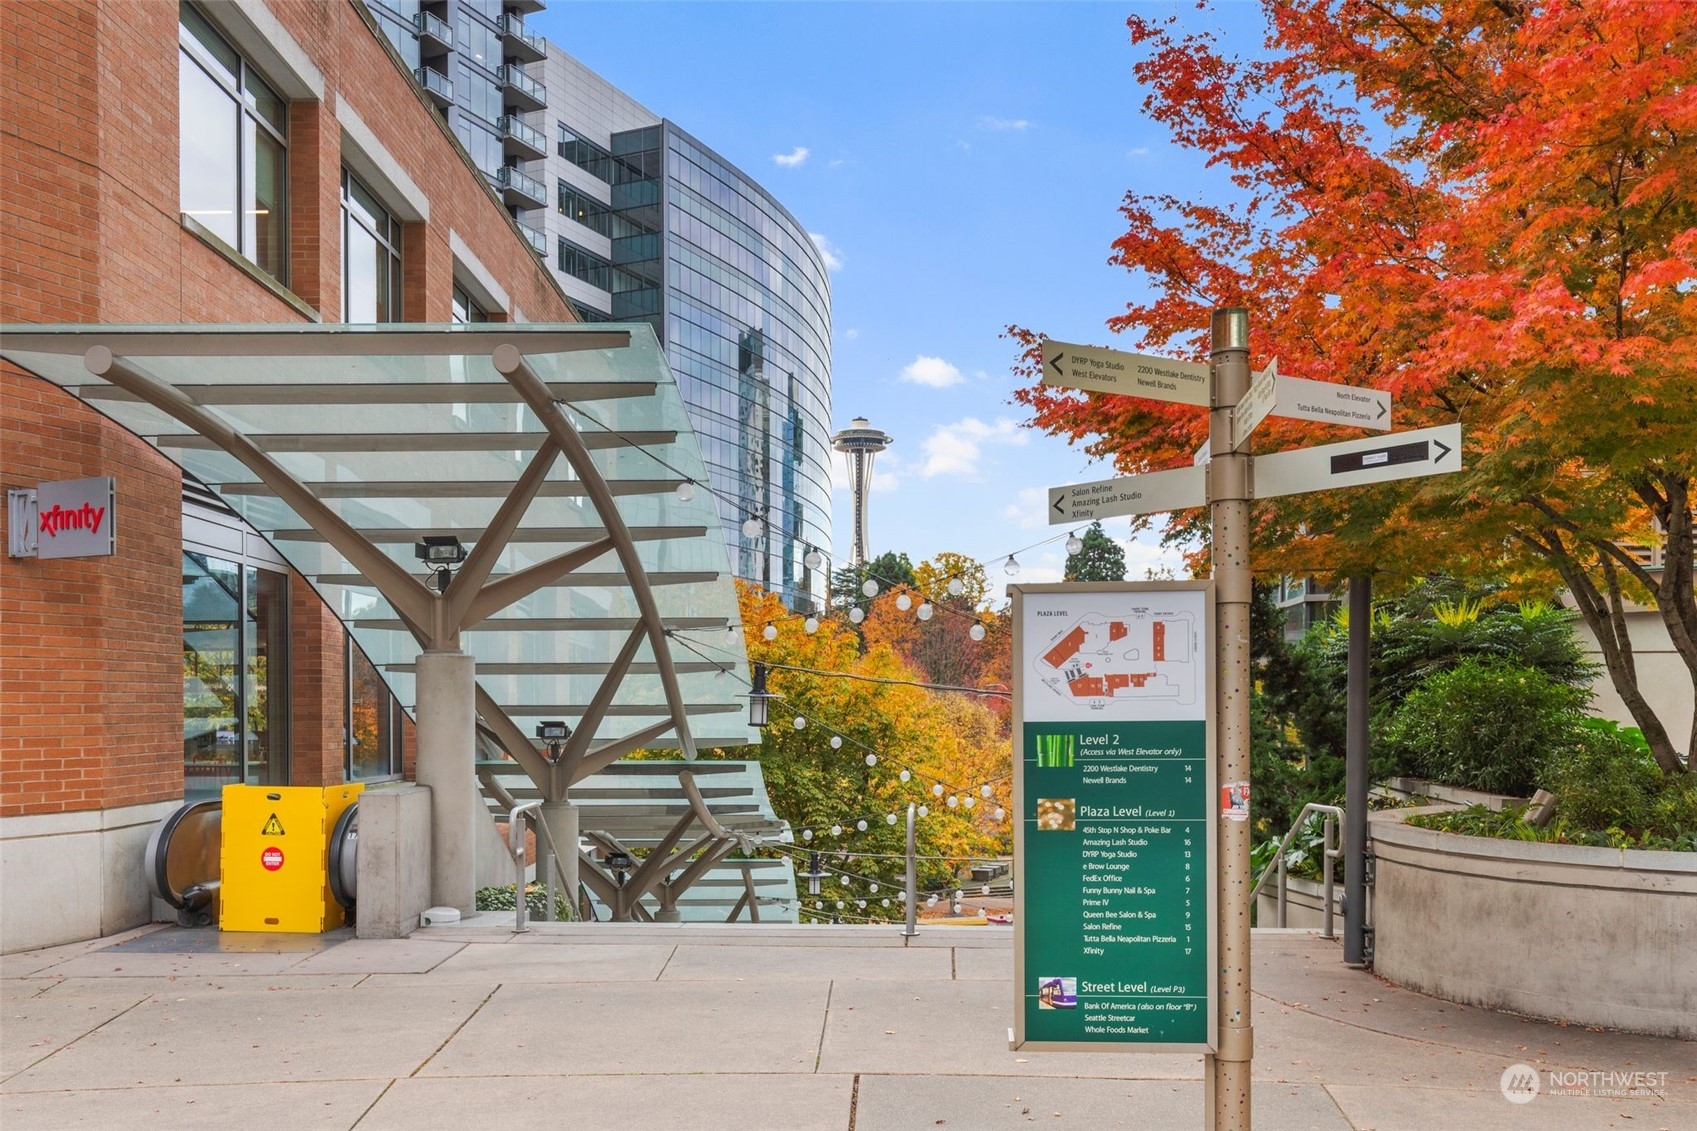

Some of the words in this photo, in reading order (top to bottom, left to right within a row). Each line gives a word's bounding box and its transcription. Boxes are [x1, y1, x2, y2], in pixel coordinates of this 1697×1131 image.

[1071, 355, 1089, 365] DYRP
[1089, 358, 1105, 369] Yoga
[1105, 360, 1125, 371] Studio
[1071, 369, 1088, 378] West
[1089, 371, 1117, 383] Elevators
[1137, 365, 1153, 374] 2200
[1153, 367, 1179, 379] Westlake
[1180, 371, 1206, 384] Dentistry
[1137, 378, 1156, 388] Newell
[1157, 380, 1177, 390] Brands
[1336, 391, 1350, 400] North
[1351, 393, 1371, 403] Elevator
[1297, 403, 1310, 412] Tutta
[1311, 405, 1324, 414] Bella
[1324, 407, 1351, 418] Neapolitan
[1351, 411, 1371, 420] Pizzeria
[1072, 487, 1090, 497] Salon
[1091, 484, 1113, 494] Refine
[1072, 497, 1100, 508] Amazing
[1101, 494, 1118, 504] Lash
[1119, 491, 1142, 502] Studio
[1072, 508, 1094, 519] Xfinity
[39, 502, 105, 537] xfinity
[1080, 734, 1108, 745] Level
[1112, 734, 1120, 745] 2
[1080, 748, 1104, 756] (Access
[1105, 748, 1116, 756] via
[1118, 748, 1135, 756] West
[1135, 747, 1162, 756] Elevator
[1163, 748, 1182, 757] only)
[1083, 765, 1099, 774] 2200
[1100, 765, 1128, 774] Westlake
[1129, 765, 1159, 774] Dentistry
[1184, 765, 1192, 773] 14
[1083, 776, 1104, 785] Newell
[1105, 776, 1127, 785] Brands
[1184, 776, 1192, 784] 14
[1080, 805, 1110, 817] Plaza
[1113, 805, 1142, 817] Level
[1145, 809, 1167, 818] (Level
[1168, 809, 1176, 818] 1)
[1083, 827, 1096, 835] 45th
[1097, 827, 1112, 835] Stop
[1120, 827, 1136, 835] Shop
[1144, 827, 1159, 835] Poke
[1161, 827, 1172, 835] Bar
[1184, 827, 1190, 835] 4
[1083, 839, 1110, 847] Amazing
[1111, 839, 1127, 847] Lash
[1127, 839, 1148, 847] Studio
[1184, 839, 1192, 847] 16
[1083, 851, 1099, 859] DYRP
[1100, 851, 1116, 859] Yoga
[1117, 851, 1138, 859] Studio
[1184, 851, 1191, 859] 13
[1088, 863, 1105, 871] Brow
[1106, 863, 1130, 871] Lounge
[1184, 863, 1191, 871] 8
[1184, 875, 1191, 883] 6
[1083, 887, 1102, 895] Funny
[1103, 887, 1123, 895] Bunny
[1123, 887, 1136, 895] Nail
[1143, 887, 1156, 895] Spa
[1185, 887, 1191, 895] 7
[1185, 899, 1191, 907] 5
[1083, 911, 1104, 919] Queen
[1105, 911, 1118, 919] Bee
[1119, 911, 1136, 919] Salon
[1144, 911, 1157, 919] Spa
[1185, 911, 1191, 919] 9
[1184, 923, 1192, 931] 15
[1084, 935, 1100, 943] Tutta
[1101, 935, 1116, 943] Bella
[1117, 935, 1151, 943] Neapolitan
[1152, 935, 1177, 943] Pizzeria
[1186, 935, 1190, 943] 1
[1083, 947, 1105, 956] Xfinity
[1184, 947, 1192, 955] 17
[1081, 981, 1116, 993] Street
[1118, 981, 1147, 993] Level
[1150, 985, 1172, 994] (Level
[1172, 986, 1186, 995] P3)
[1084, 1002, 1100, 1010] Bank
[1101, 1002, 1110, 1010] Of
[1110, 1002, 1136, 1010] America
[1137, 1003, 1154, 1011] (also
[1165, 1003, 1182, 1011] floor
[1085, 1014, 1107, 1022] Seattle
[1107, 1014, 1136, 1022] Streetcar
[1085, 1026, 1105, 1034] Whole
[1106, 1026, 1126, 1034] Foods
[1127, 1026, 1149, 1034] Market
